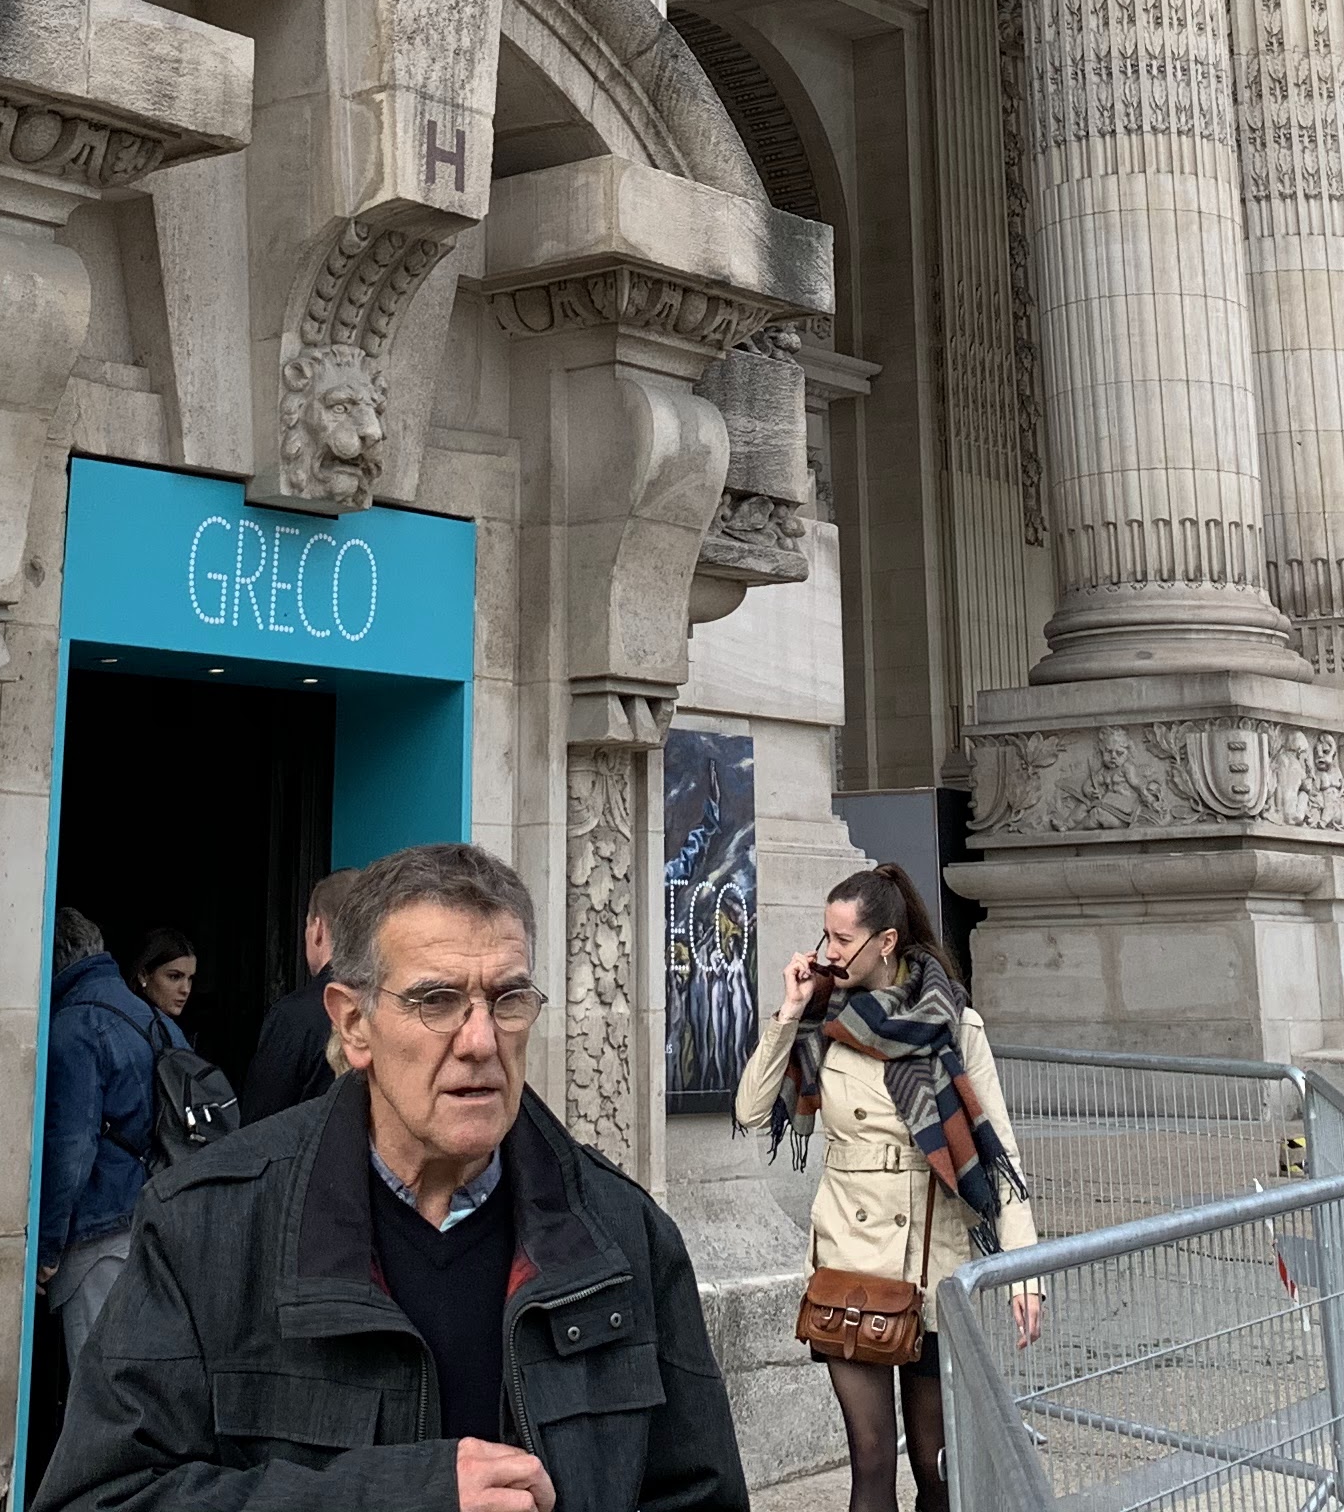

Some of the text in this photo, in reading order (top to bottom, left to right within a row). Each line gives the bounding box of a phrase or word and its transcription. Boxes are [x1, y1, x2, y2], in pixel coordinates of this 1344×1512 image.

[425, 119, 466, 194] H
[188, 515, 378, 643] GRECO
[666, 878, 749, 973] ECO
